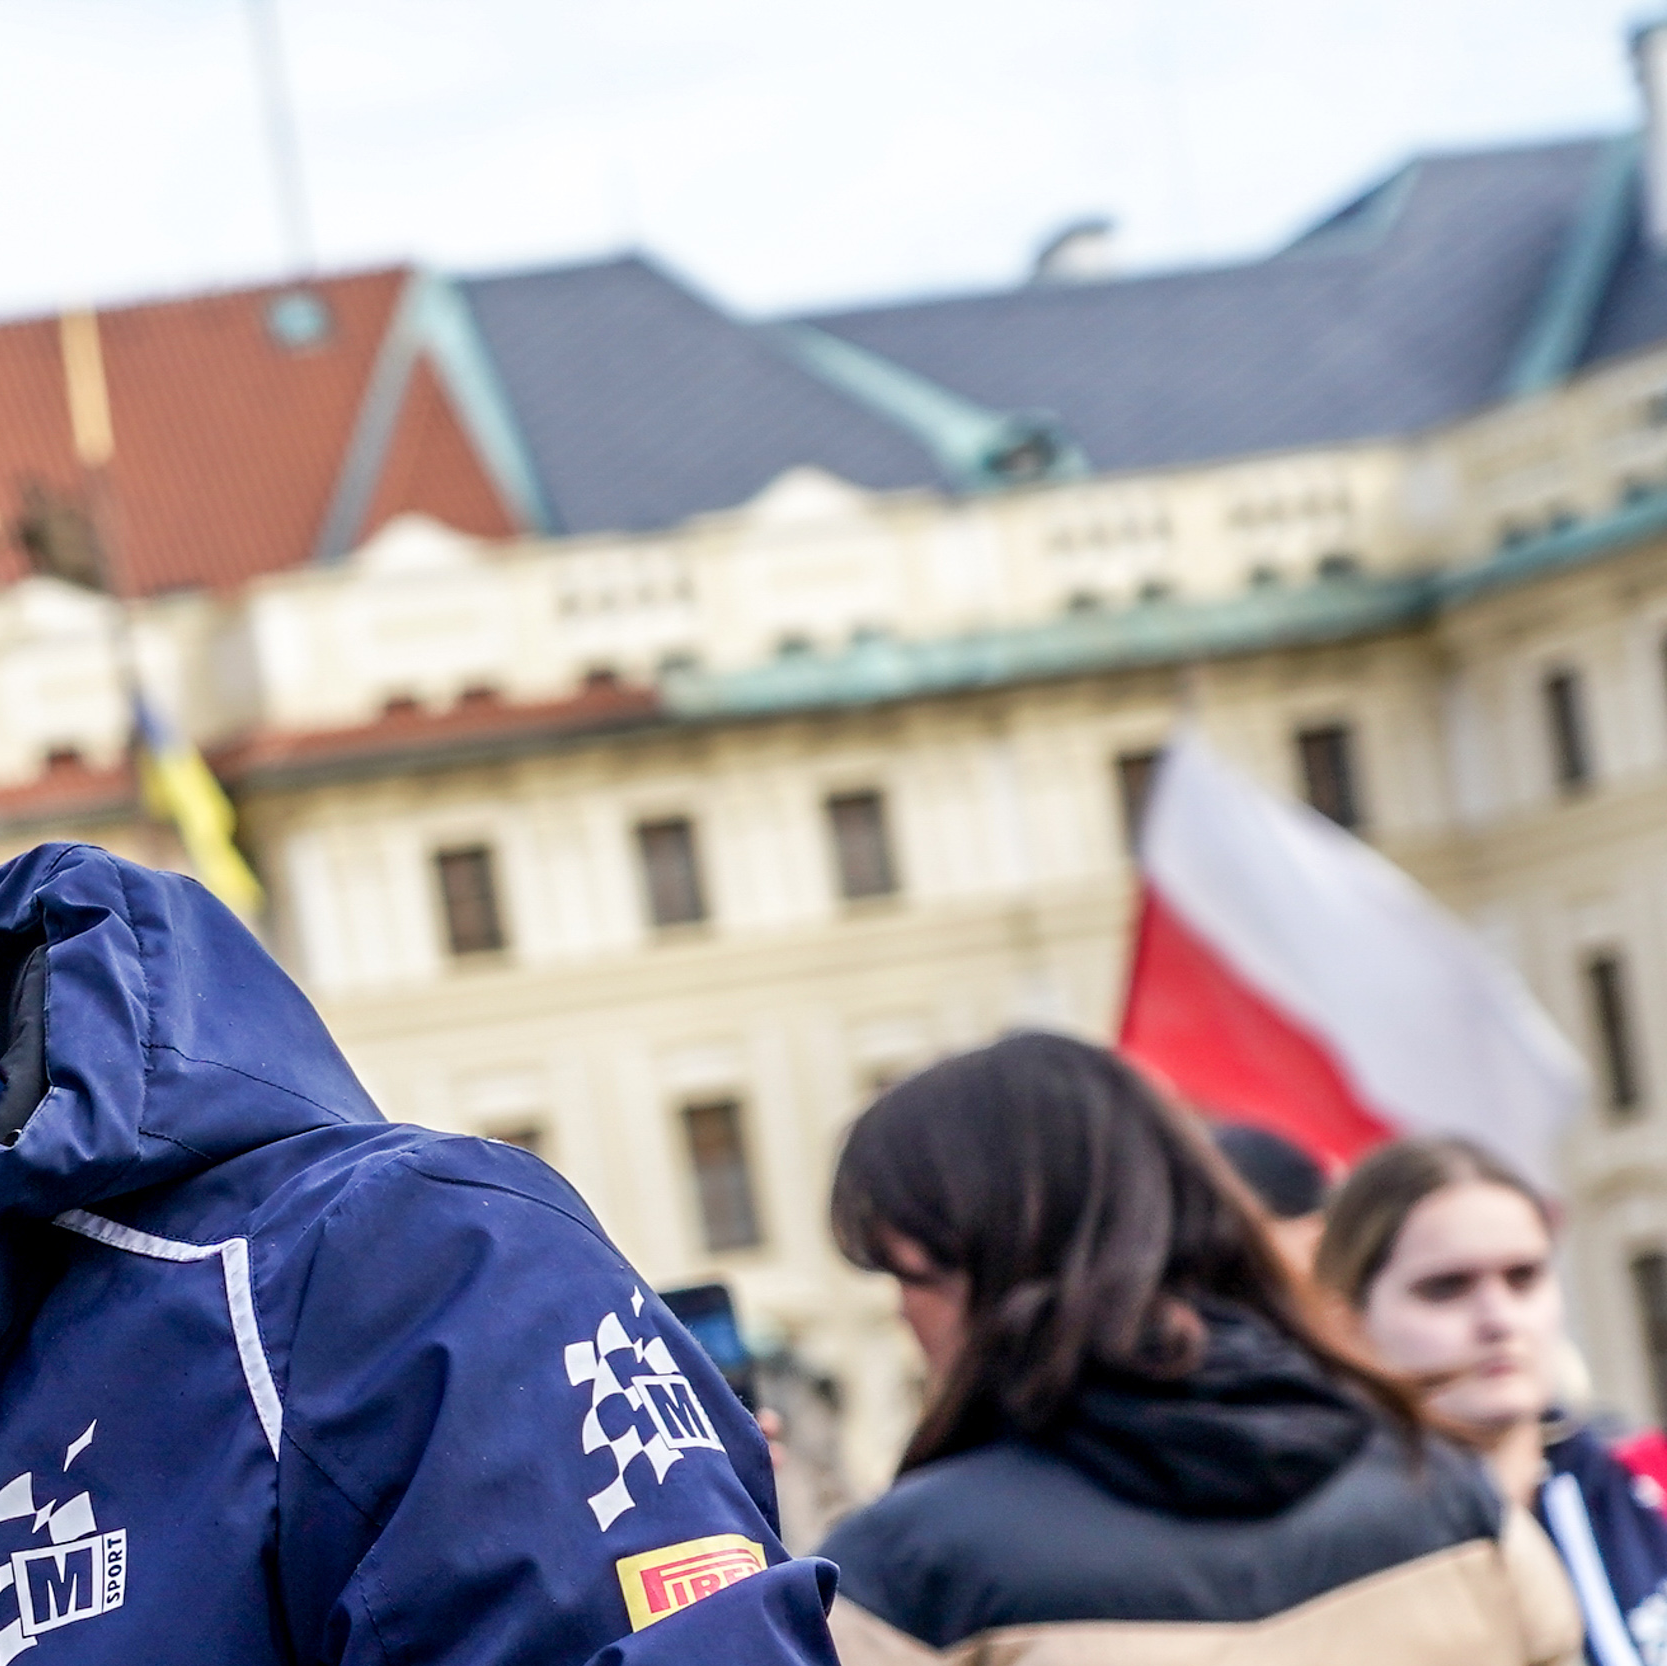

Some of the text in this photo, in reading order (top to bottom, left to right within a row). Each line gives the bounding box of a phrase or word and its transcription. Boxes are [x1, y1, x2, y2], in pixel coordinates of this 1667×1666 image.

[23, 1535, 124, 1631] M SPORT
[639, 1548, 763, 1615] PIRE
